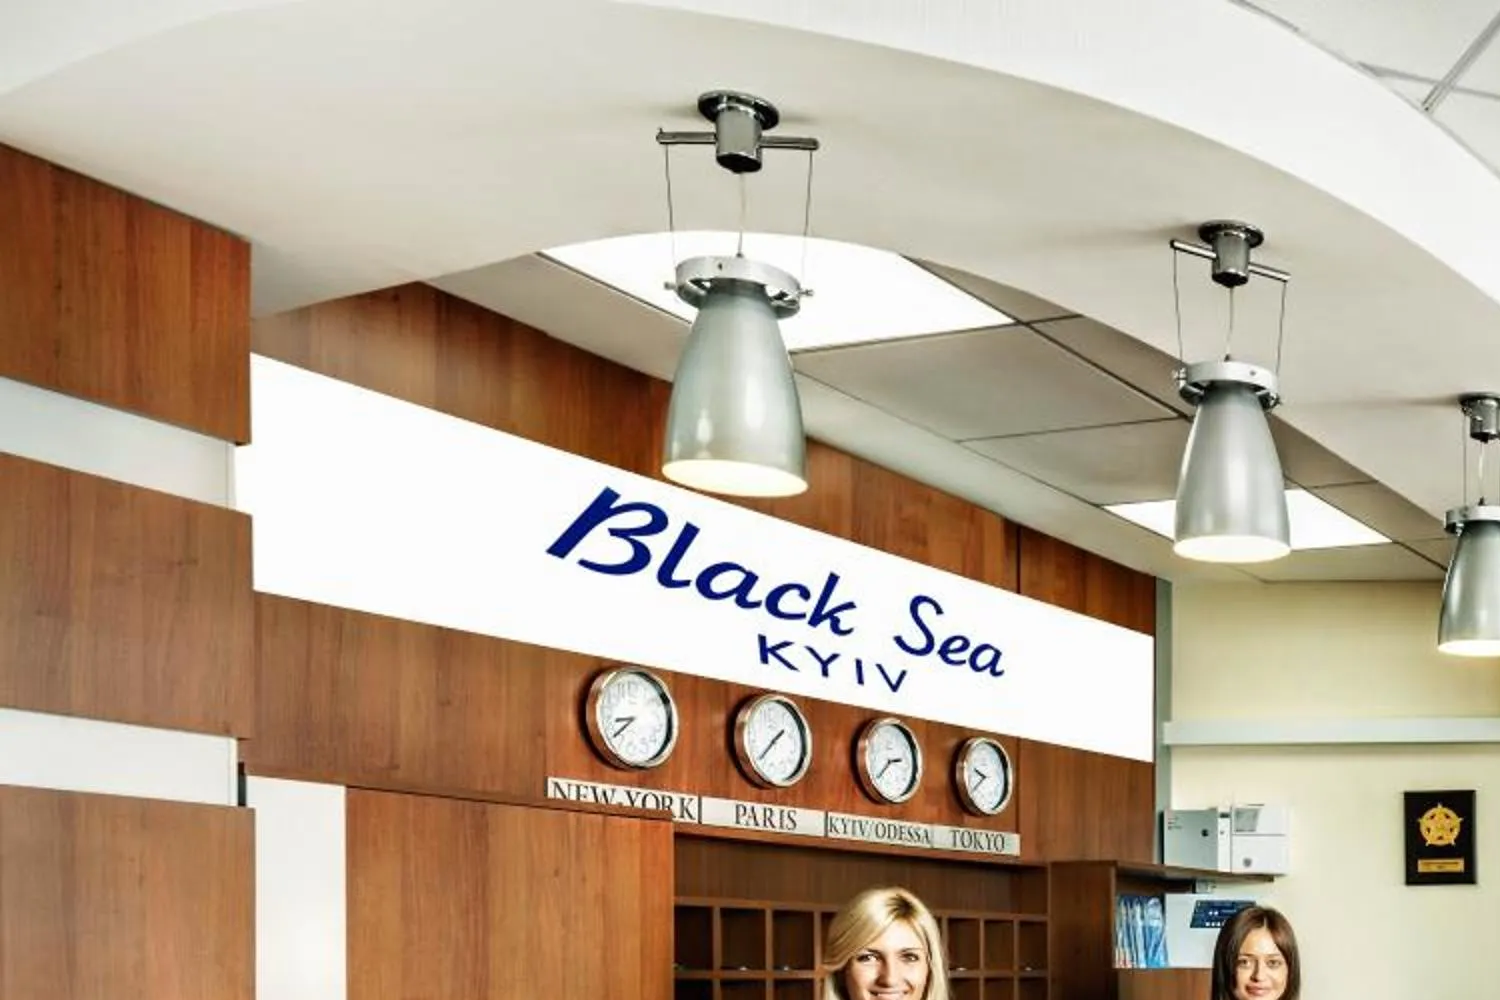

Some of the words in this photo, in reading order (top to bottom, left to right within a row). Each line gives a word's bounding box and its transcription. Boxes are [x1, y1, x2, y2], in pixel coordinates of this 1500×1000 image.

[546, 487, 856, 635] Black
[893, 595, 1004, 677] Sea
[758, 634, 907, 692] KYIV
[734, 803, 797, 831] PARIS
[828, 816, 932, 845] KYIV/ODESSA
[950, 829, 1005, 851] TOKYO
